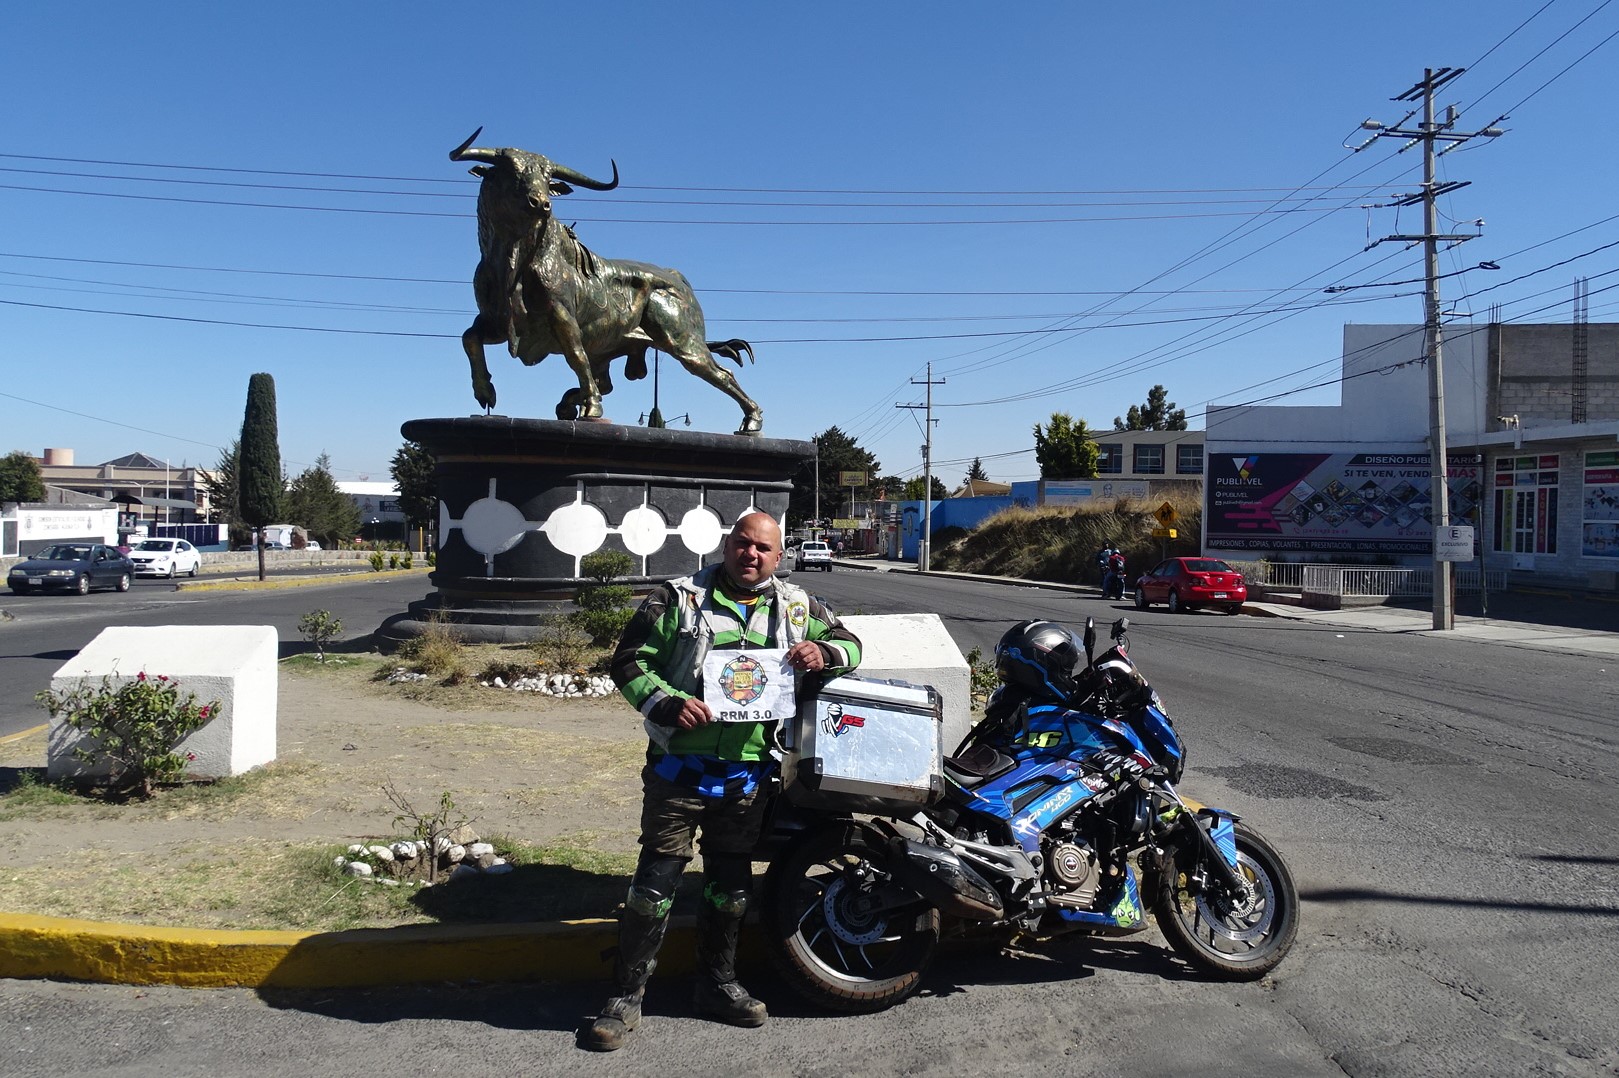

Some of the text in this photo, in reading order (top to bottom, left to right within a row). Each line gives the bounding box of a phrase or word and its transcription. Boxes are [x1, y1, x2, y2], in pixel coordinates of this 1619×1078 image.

[1365, 455, 1404, 464] DISEÑO
[1344, 469, 1353, 477] SI
[1452, 530, 1459, 538] E
[720, 710, 772, 721] RRM 3.0
[1015, 732, 1062, 748] 46
[1051, 794, 1071, 813] 400
